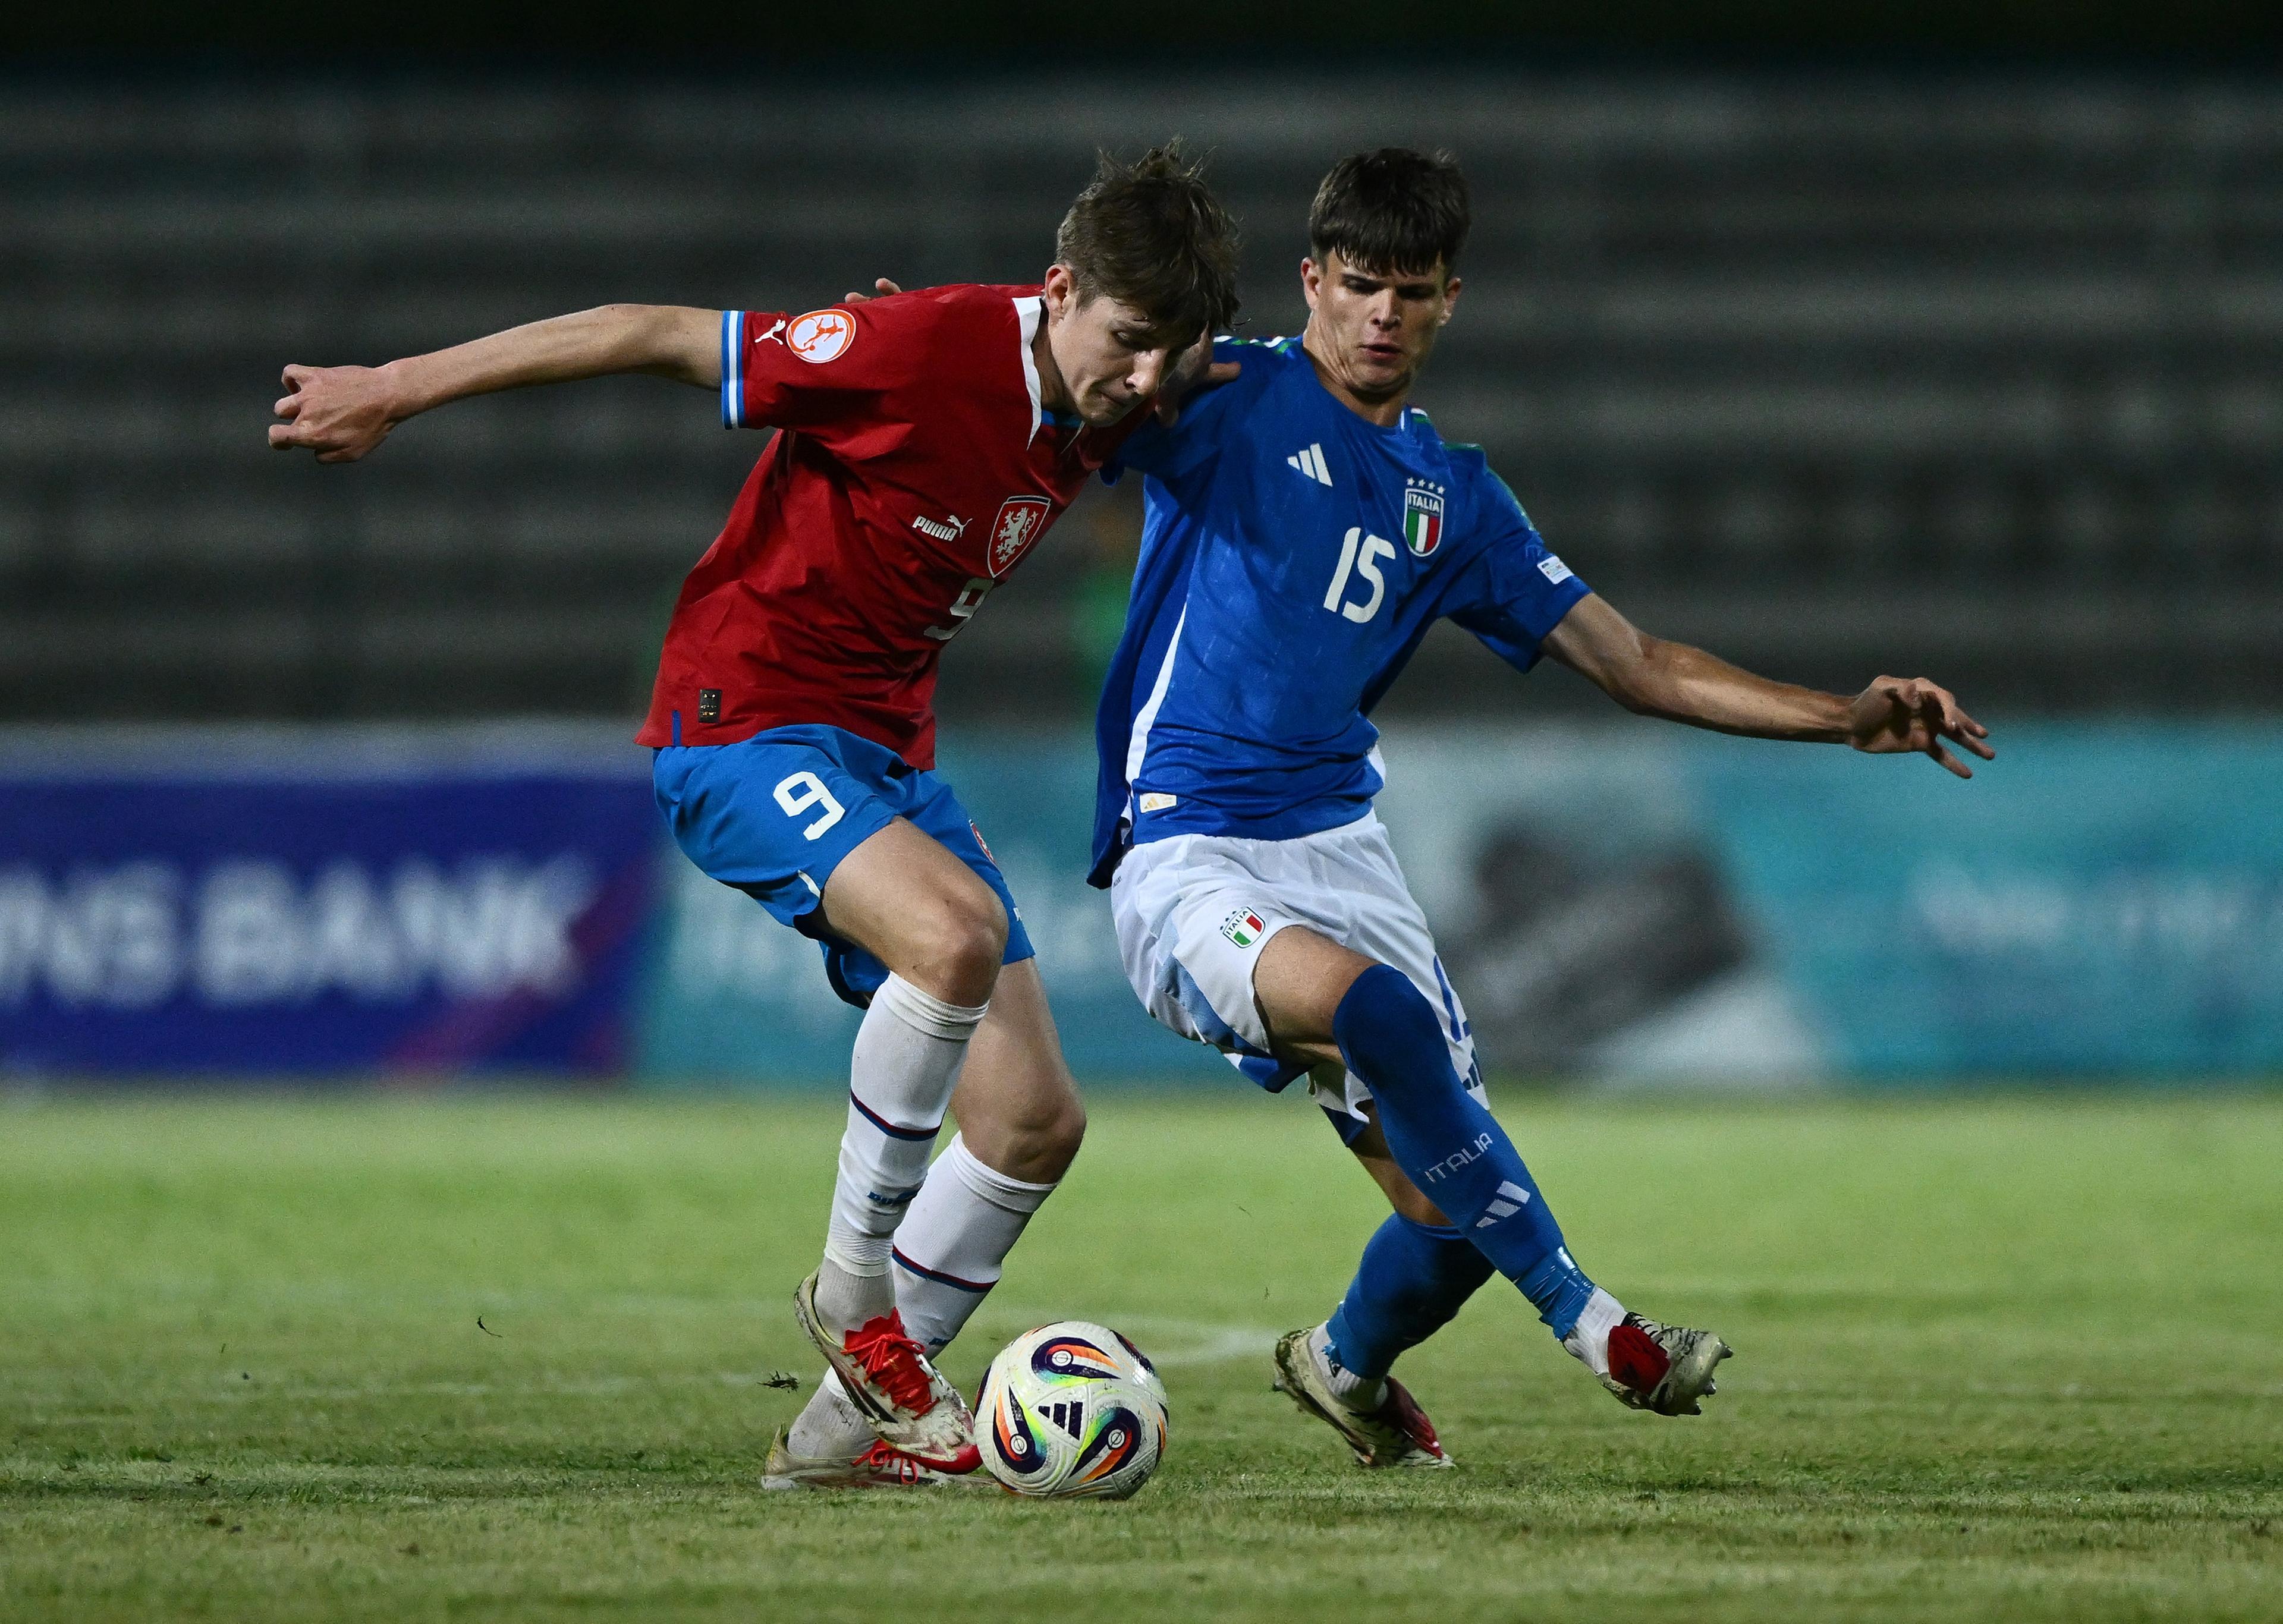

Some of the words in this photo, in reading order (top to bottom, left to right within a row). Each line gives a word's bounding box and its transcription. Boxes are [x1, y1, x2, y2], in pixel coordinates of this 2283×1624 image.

[912, 515, 958, 542] PUMA
[1408, 493, 1440, 512] ITALIA
[1323, 527, 1396, 624] 15
[923, 577, 995, 641] 9
[773, 771, 845, 841] 9
[193, 853, 589, 1012] BANK
[1226, 911, 1248, 935] ITALIA
[1424, 1132, 1493, 1184] ITALIA
